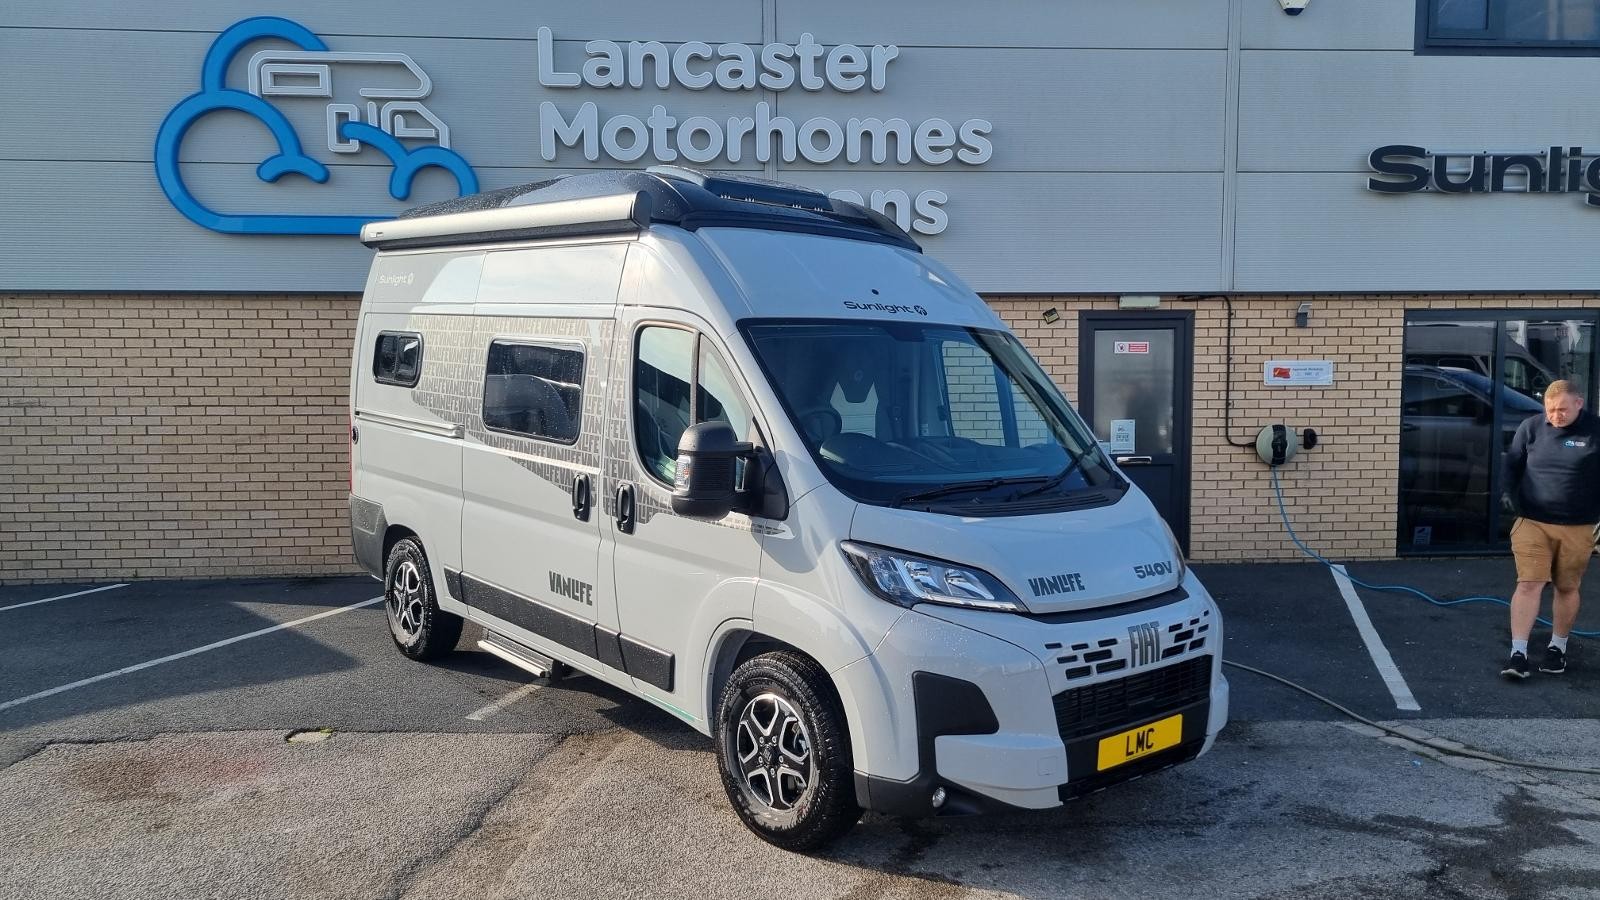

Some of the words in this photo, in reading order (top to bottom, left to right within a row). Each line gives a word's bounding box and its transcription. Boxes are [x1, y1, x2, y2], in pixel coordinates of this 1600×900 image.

[537, 26, 899, 92] Lancaster
[539, 101, 993, 166] Motorhomes
[1367, 144, 1600, 207] Sunli
[378, 273, 408, 287] Sunlight
[843, 301, 914, 314] Sunlight
[1028, 573, 1085, 597] VANLIFE
[1133, 560, 1173, 579] 540V
[548, 570, 593, 607] VANLIFE
[1128, 621, 1161, 668] FIAT
[1126, 728, 1155, 757] LMC
